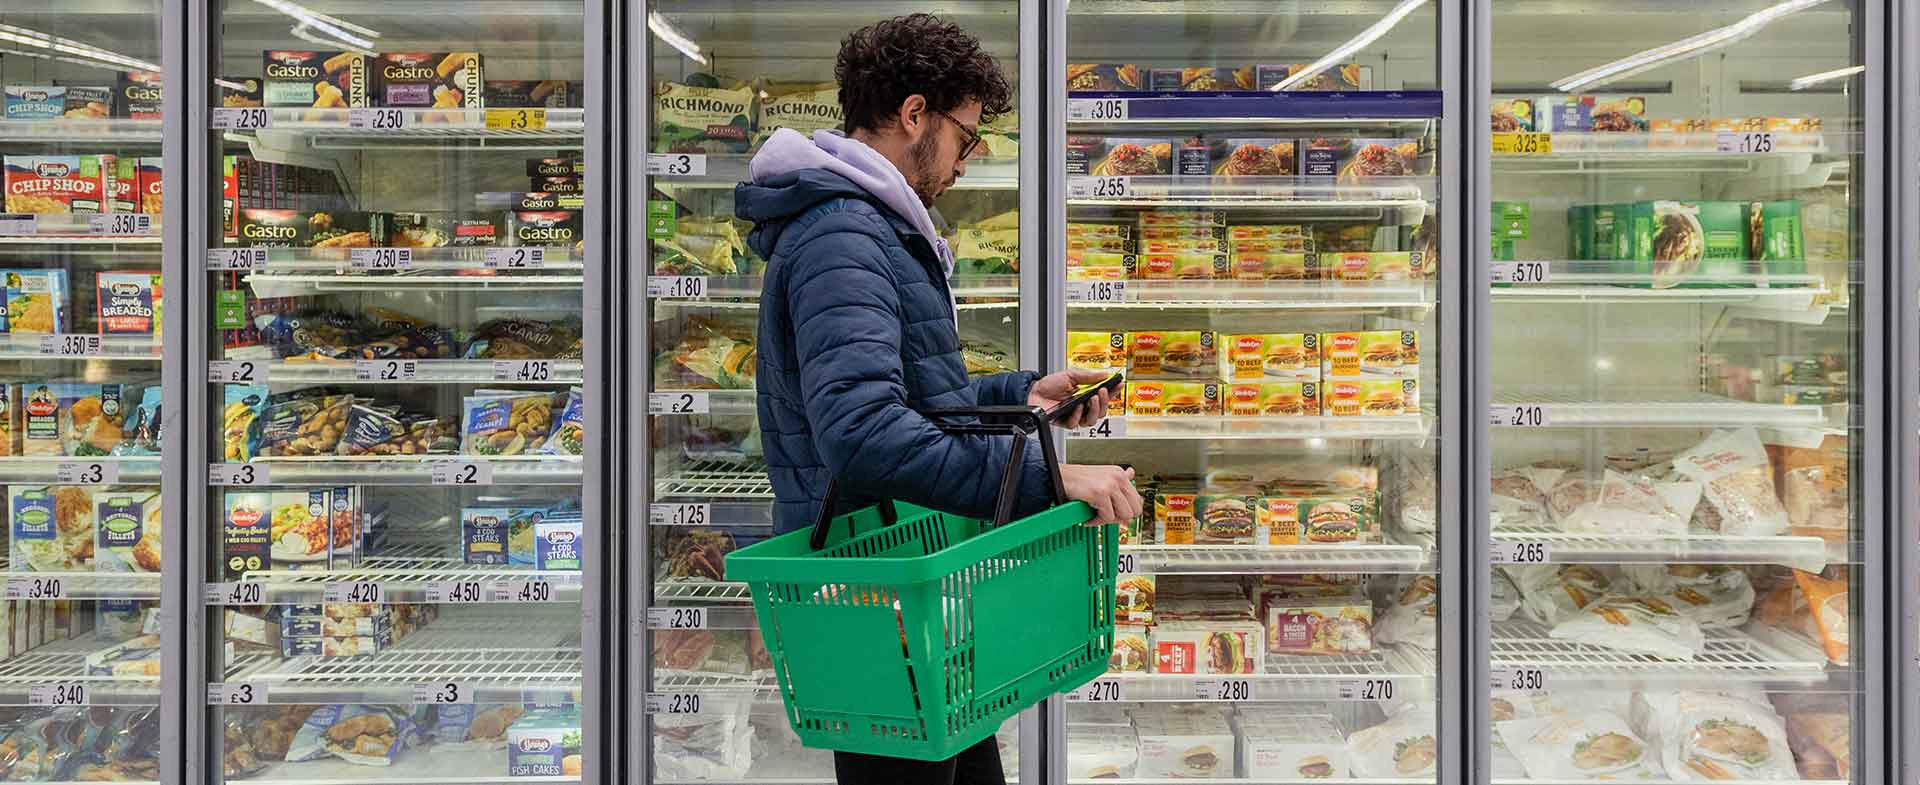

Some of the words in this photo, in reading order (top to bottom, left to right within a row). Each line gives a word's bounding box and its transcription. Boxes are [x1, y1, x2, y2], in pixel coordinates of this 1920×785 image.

[267, 64, 318, 77] Gastro
[384, 66, 434, 79] Gastro
[660, 97, 744, 113] RICHMOND
[511, 111, 527, 128] £3
[668, 156, 690, 174] £3
[12, 180, 50, 194] CHIP
[53, 179, 95, 194] SHOP
[522, 198, 554, 208] Gastro
[244, 224, 296, 238] Gastro
[519, 227, 572, 240] Gastro
[508, 250, 525, 267] £2
[103, 307, 152, 317] BREADED
[232, 362, 253, 380] £2
[381, 362, 397, 380] £2
[672, 394, 694, 412] £2
[1089, 418, 1112, 437] £4
[81, 465, 103, 483] £3
[232, 465, 254, 484] £3
[456, 465, 477, 484] £2
[472, 535, 500, 544] STEAKS
[547, 551, 577, 561] STEAKS
[231, 684, 253, 703] £3
[436, 684, 458, 702] £3
[533, 765, 559, 776] CAKES
